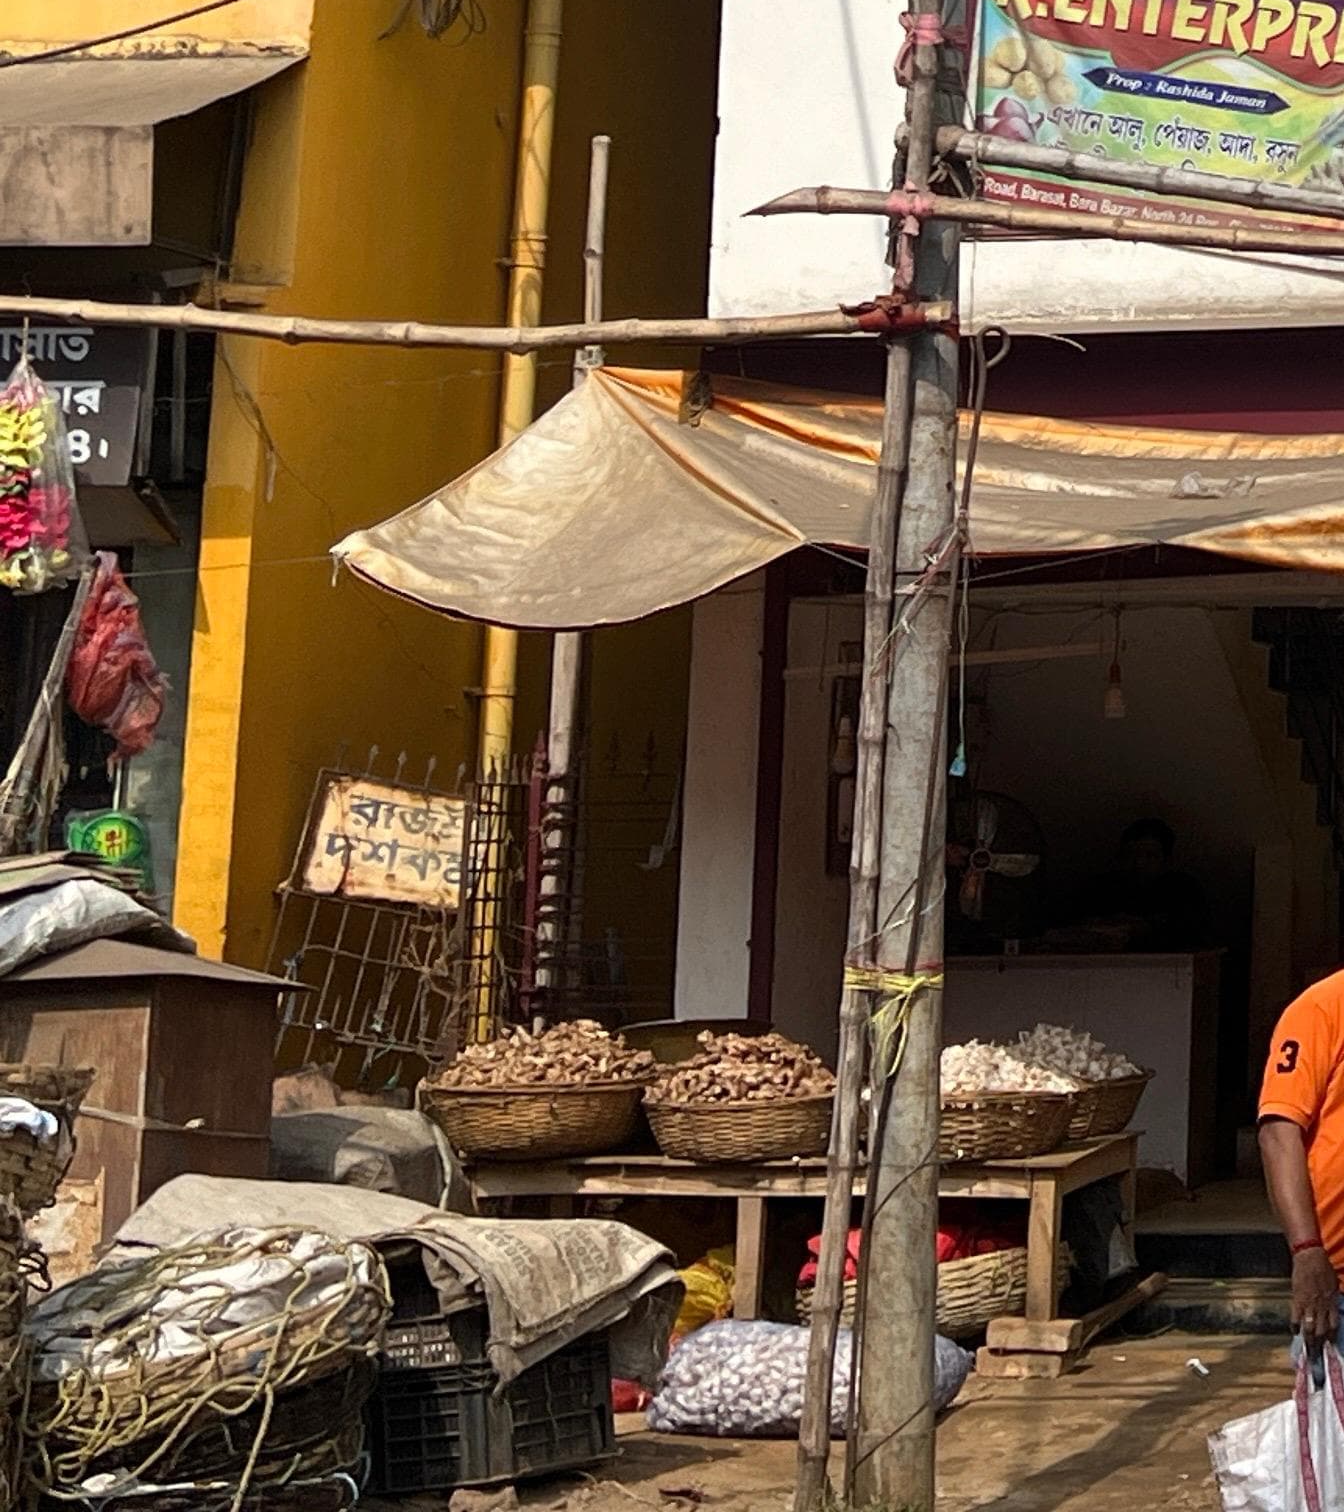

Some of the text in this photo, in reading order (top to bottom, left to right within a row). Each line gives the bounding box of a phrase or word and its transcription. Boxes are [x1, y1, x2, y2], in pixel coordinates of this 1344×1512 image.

[1105, 71, 1143, 92] Prop
[1155, 80, 1214, 102] Rashida
[1049, 105, 1105, 136] এখানে
[983, 178, 1019, 202] Road,
[1276, 1040, 1300, 1074] 3
